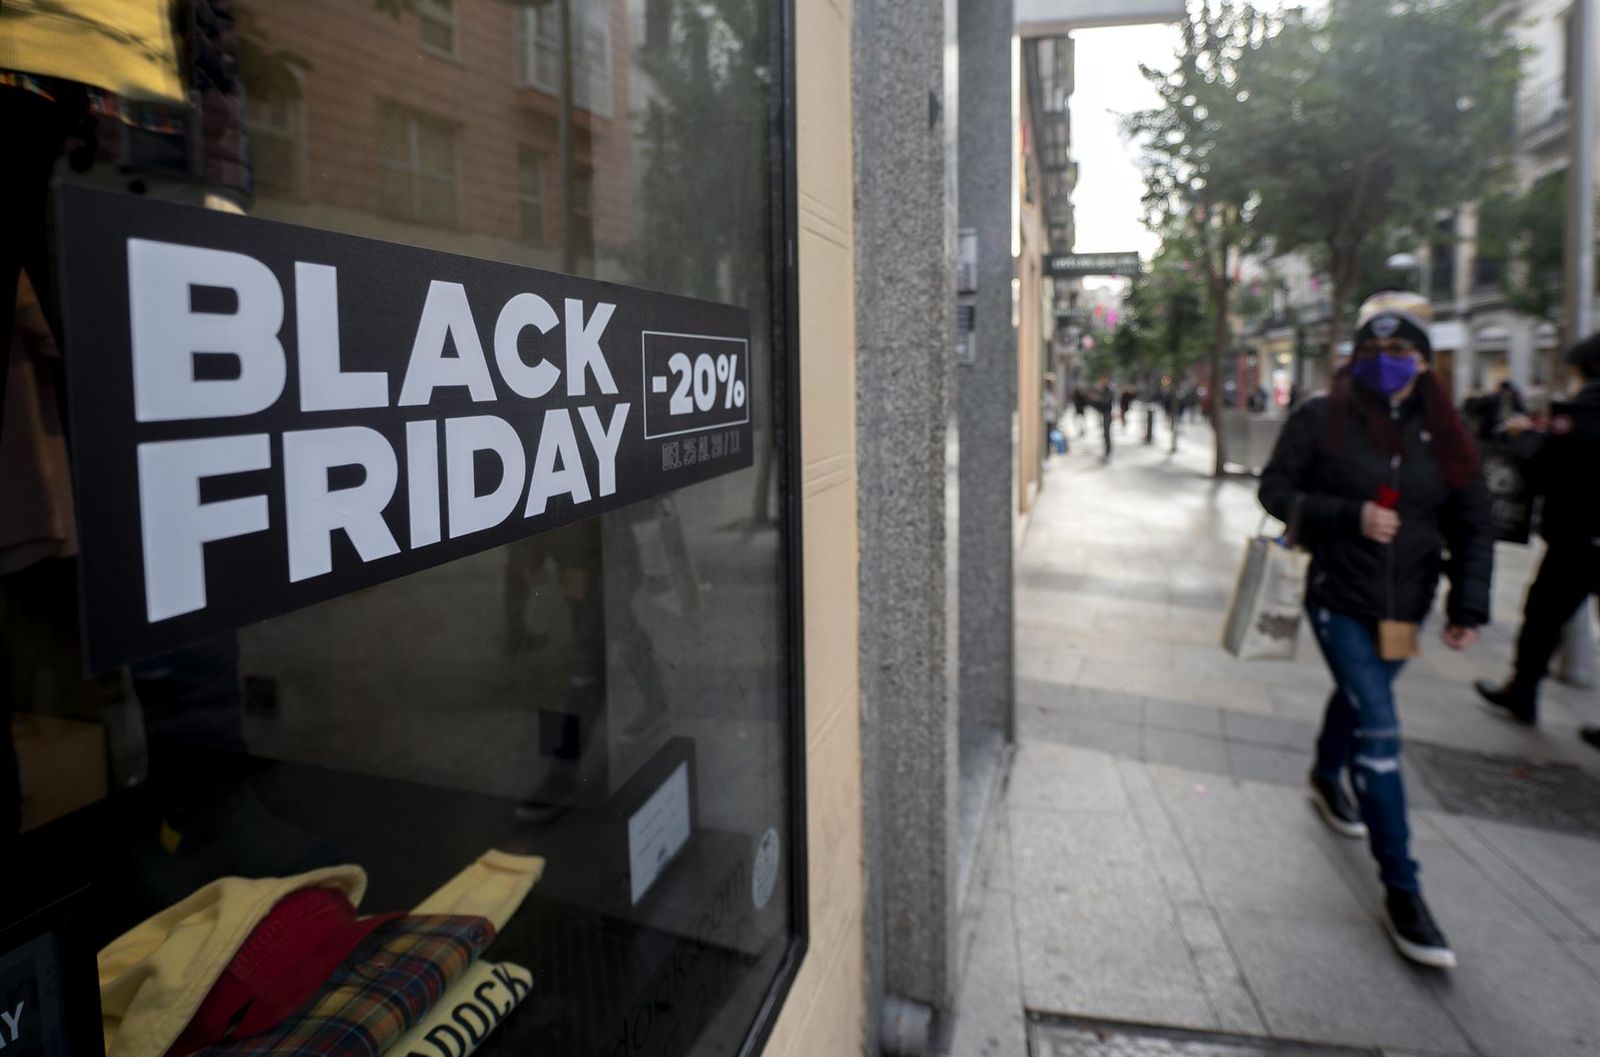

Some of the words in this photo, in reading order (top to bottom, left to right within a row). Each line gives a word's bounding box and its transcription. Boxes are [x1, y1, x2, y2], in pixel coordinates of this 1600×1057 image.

[127, 238, 618, 422] BLACK
[652, 351, 746, 416] -20%
[662, 441, 682, 472] DEL
[698, 434, 711, 462] AL
[137, 402, 631, 623] FRIDAY
[407, 962, 533, 1057] DOCK
